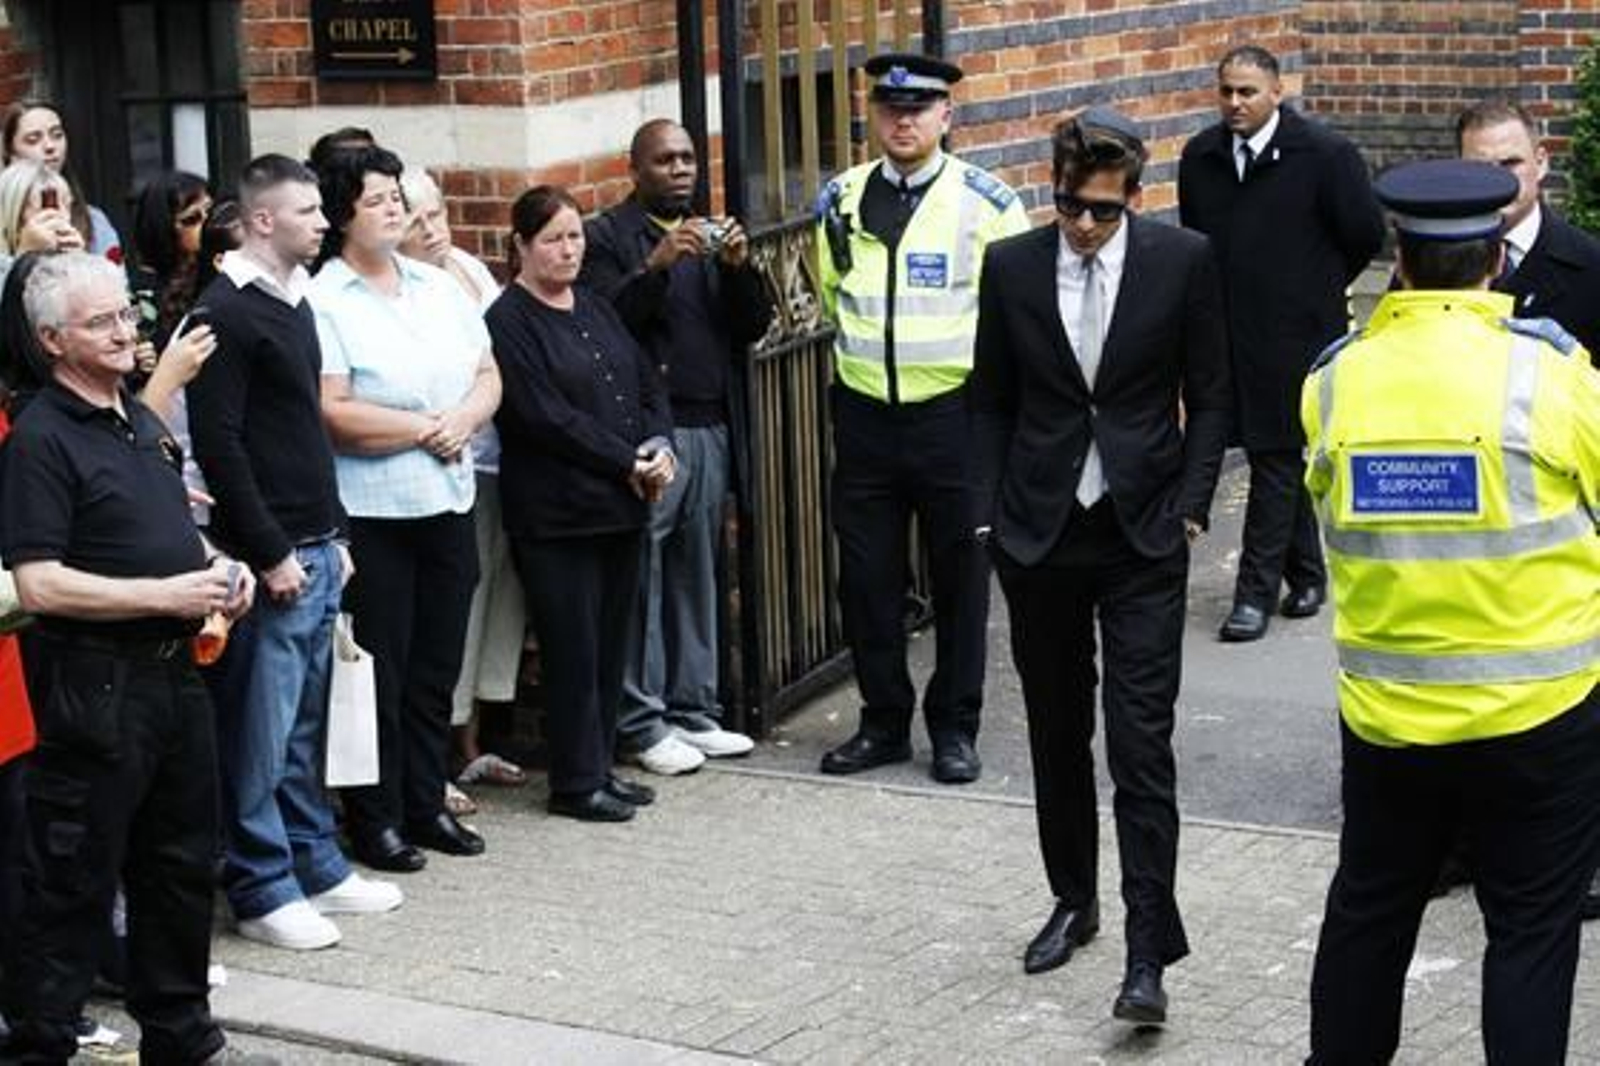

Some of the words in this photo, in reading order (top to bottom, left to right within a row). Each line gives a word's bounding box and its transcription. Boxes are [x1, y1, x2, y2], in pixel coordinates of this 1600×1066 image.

[329, 18, 417, 40] CHAPEL
[1367, 461, 1459, 474] COMMUNITY
[1378, 479, 1449, 493] SUPPORT
